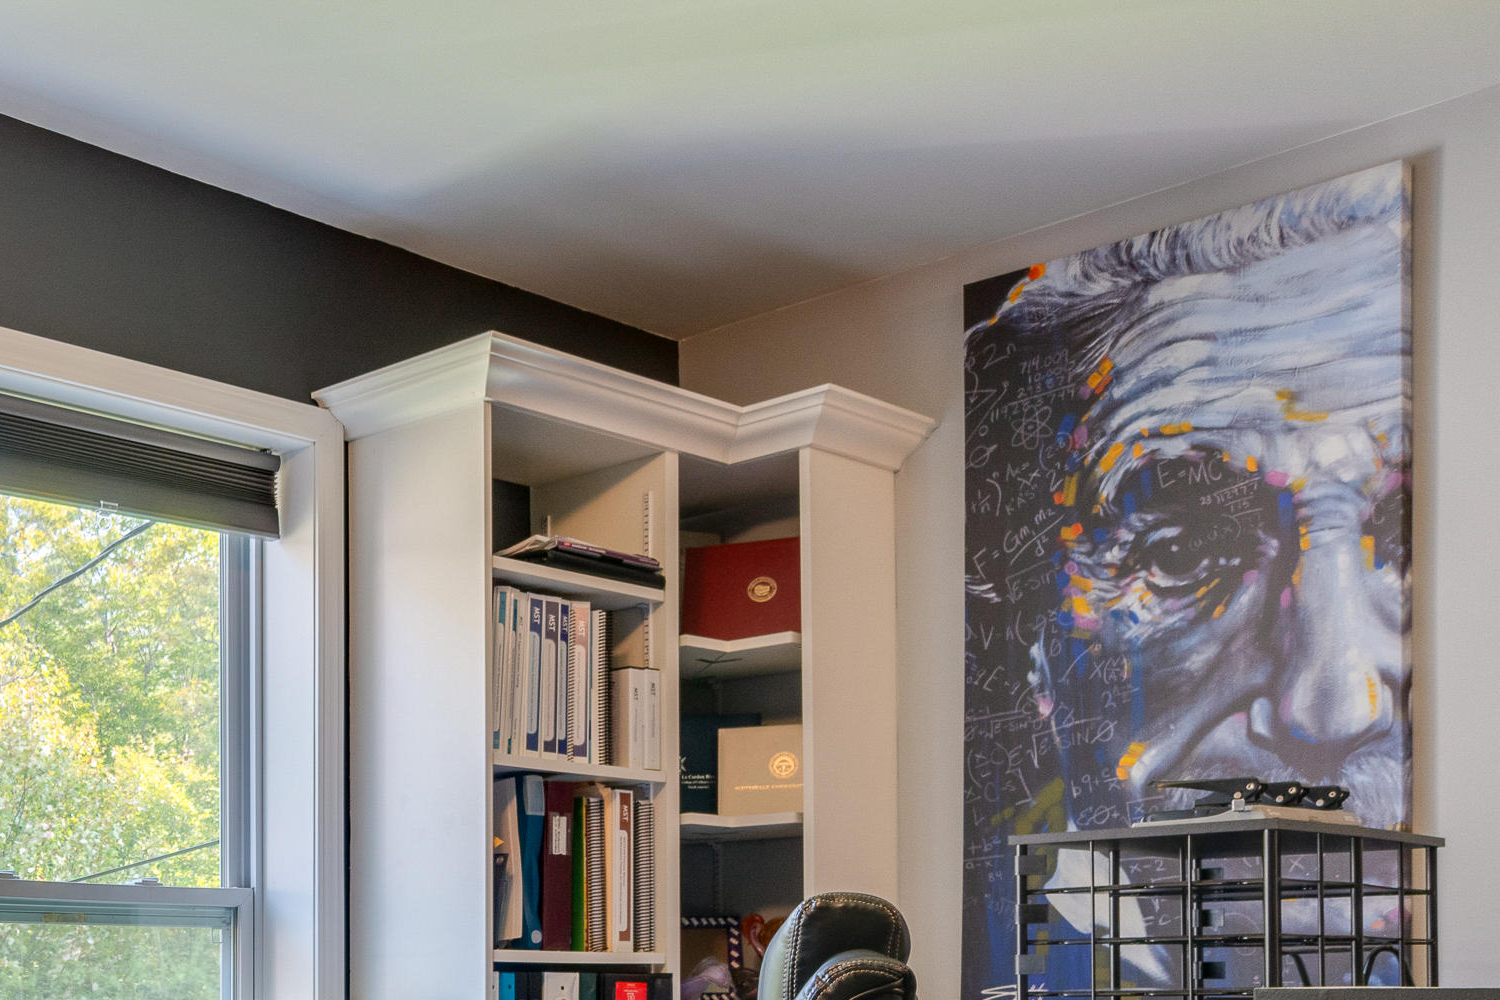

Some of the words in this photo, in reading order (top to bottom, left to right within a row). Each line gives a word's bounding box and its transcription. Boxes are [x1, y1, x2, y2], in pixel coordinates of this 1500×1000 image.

[533, 606, 541, 625] MST
[547, 613, 557, 633] MST
[577, 618, 587, 639] MST
[621, 804, 629, 823] MST
